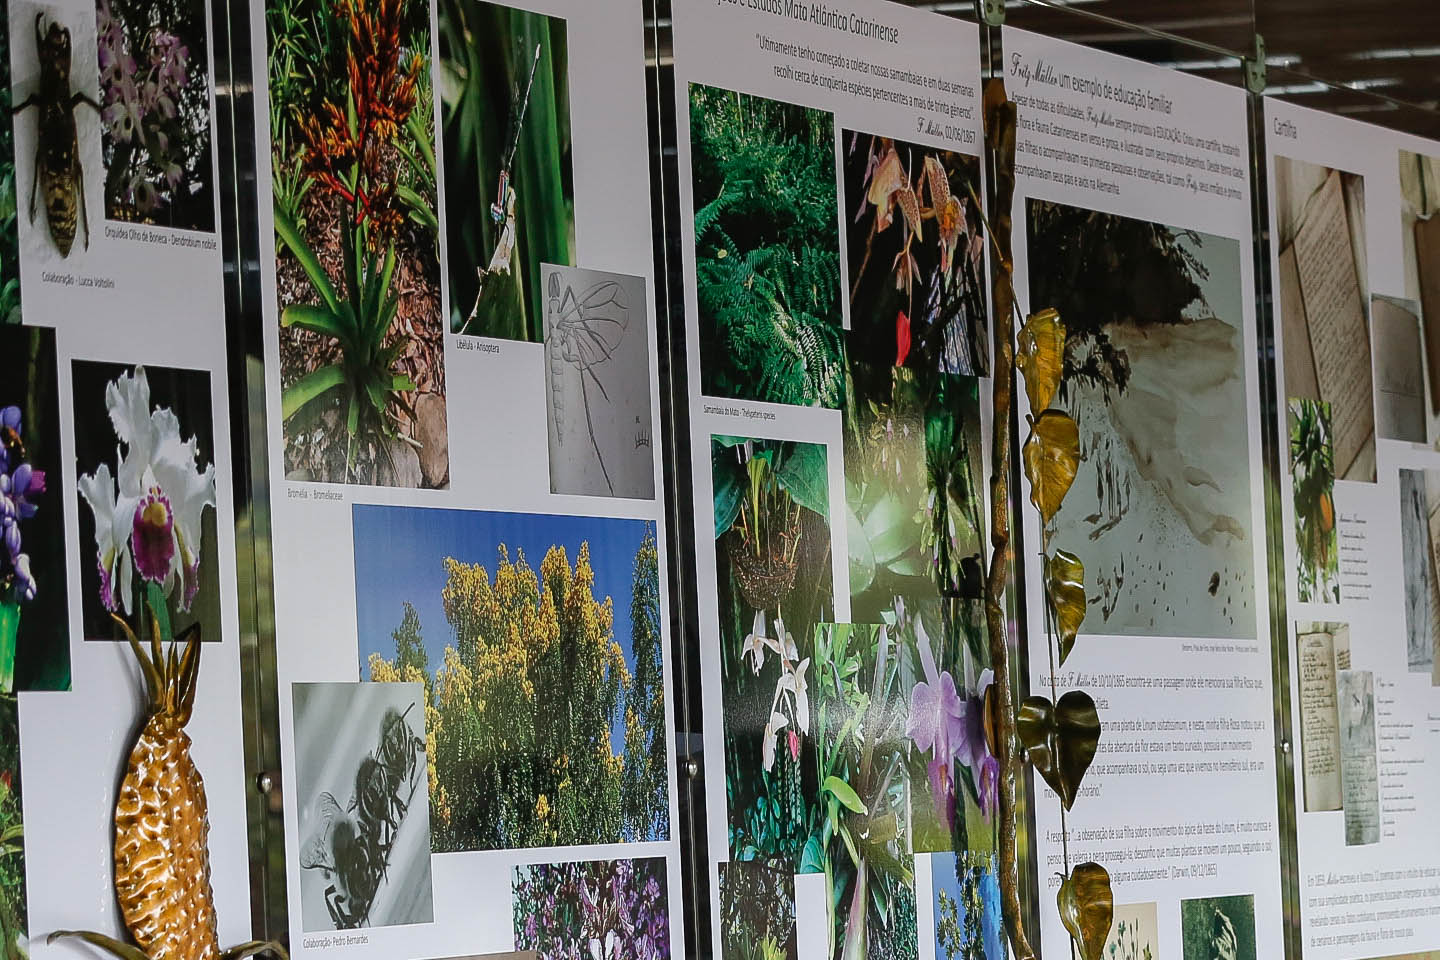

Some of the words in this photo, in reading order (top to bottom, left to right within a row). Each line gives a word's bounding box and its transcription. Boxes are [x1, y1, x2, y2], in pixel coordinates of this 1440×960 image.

[785, 0, 807, 21] Mata
[810, 5, 847, 31] Atlântica
[850, 14, 898, 44] Catarinense
[1060, 74, 1070, 88] um
[1072, 77, 1102, 99] exemplo
[1104, 80, 1112, 100] de
[1114, 84, 1146, 111] educação
[1148, 91, 1172, 114] familiar
[1274, 118, 1297, 139] Cartilha
[129, 229, 141, 241] Olho
[142, 230, 148, 242] de
[150, 232, 168, 244] Boneca
[172, 234, 200, 248] Dendrobium
[202, 238, 216, 250] nobile
